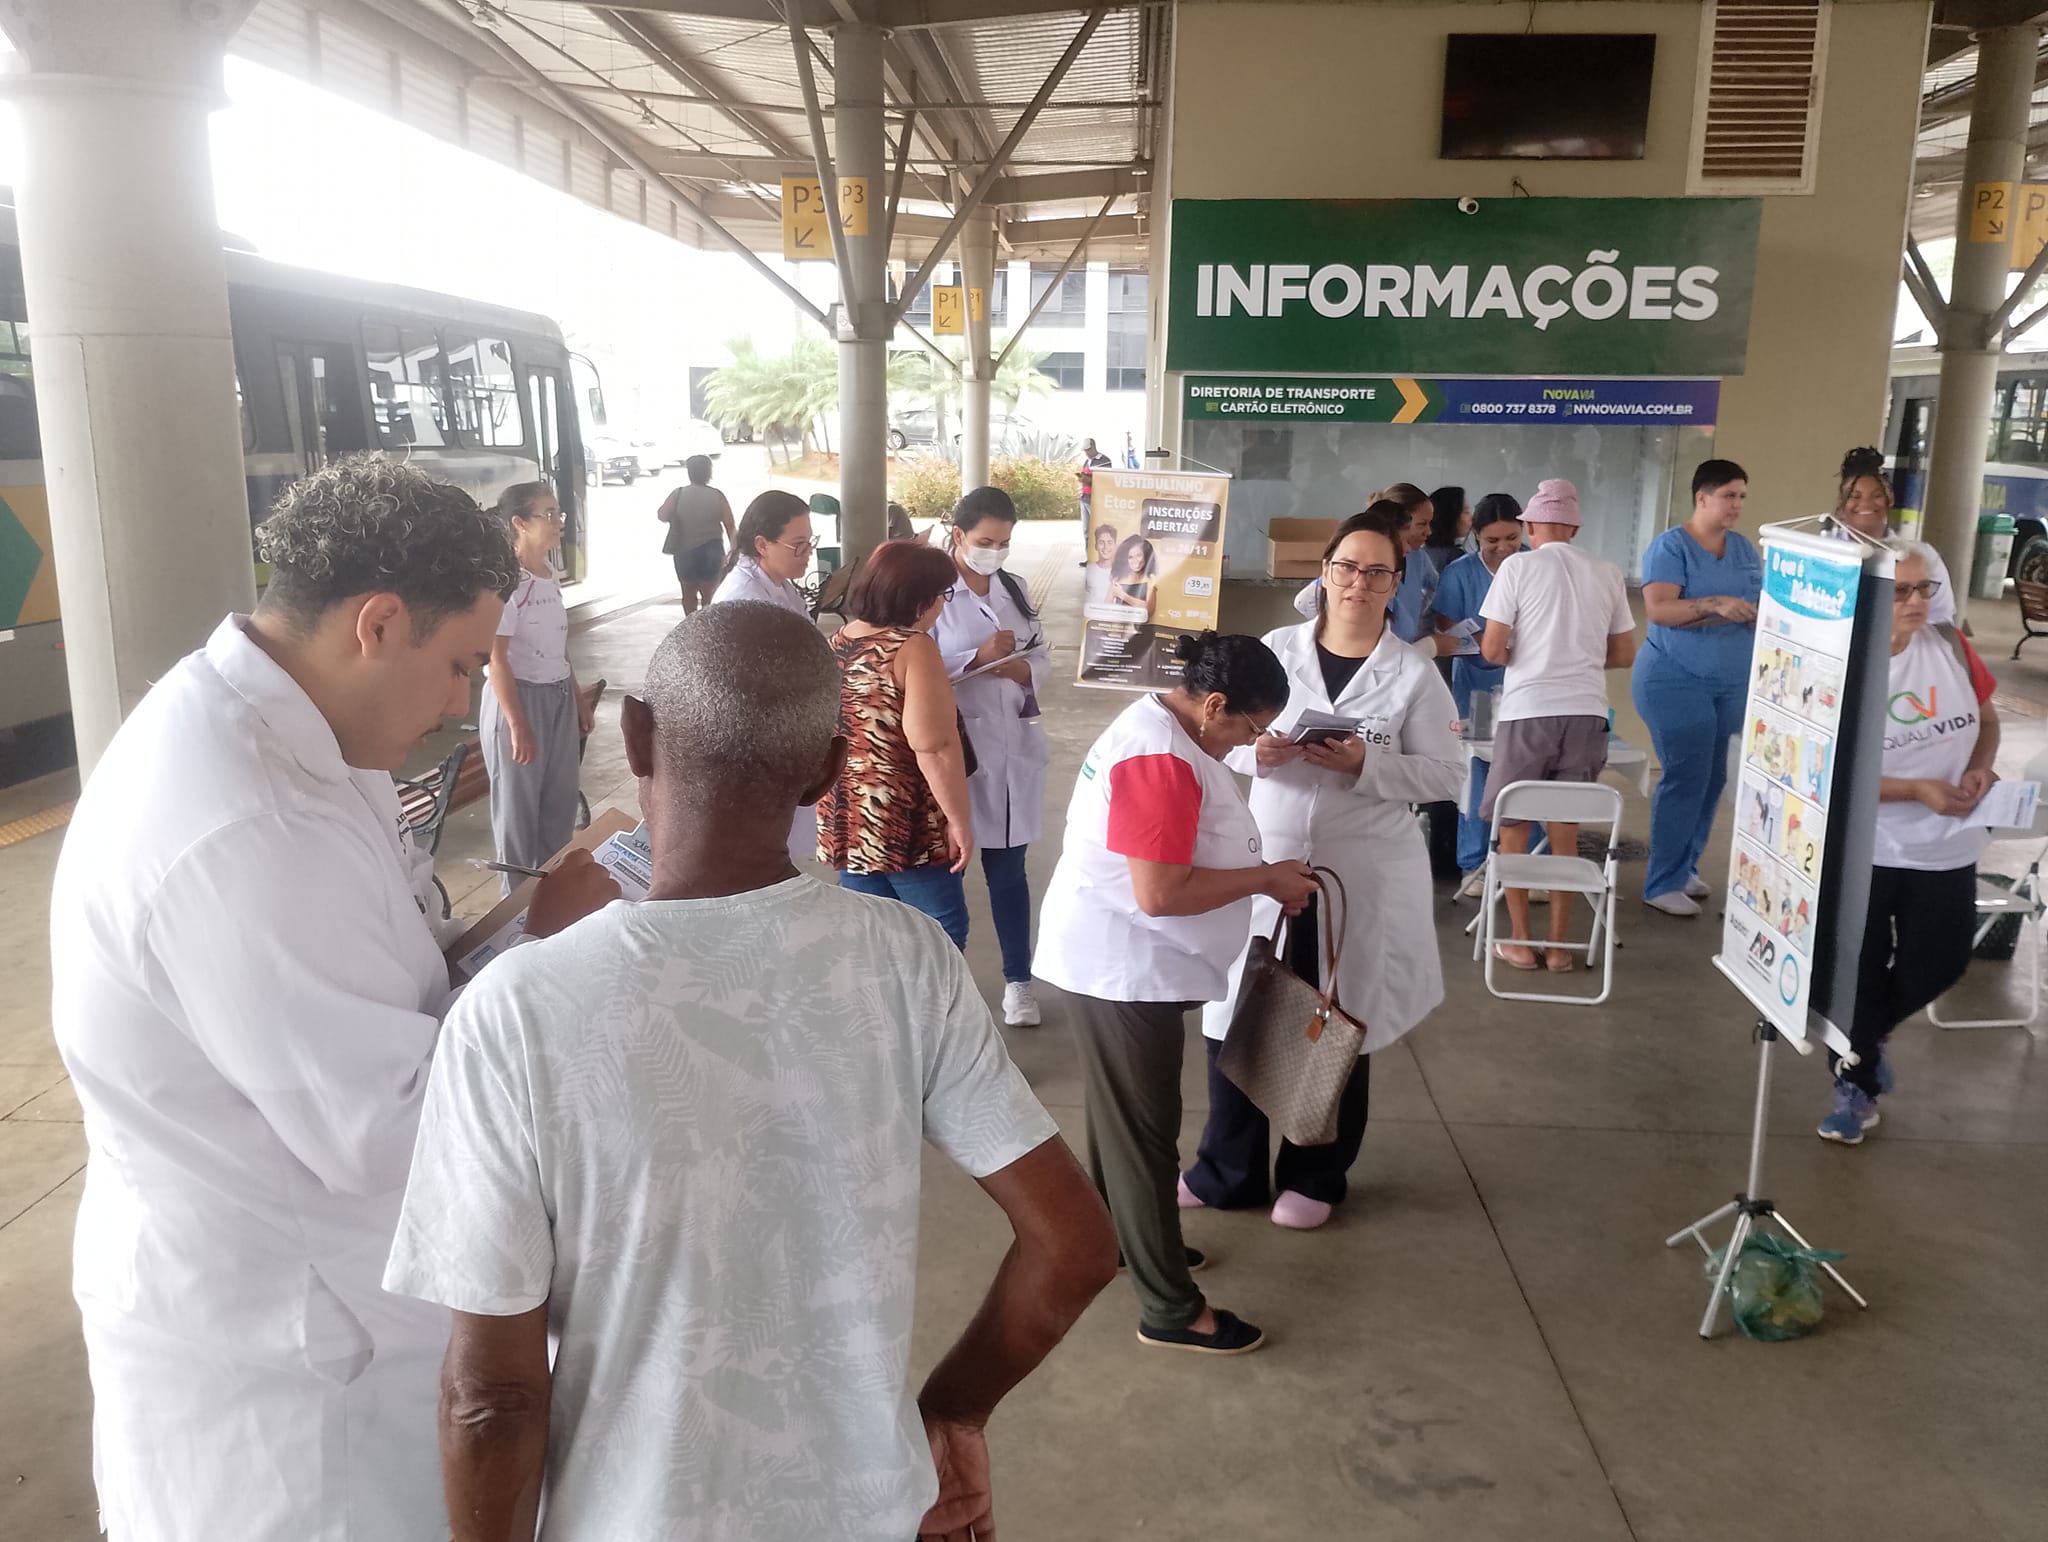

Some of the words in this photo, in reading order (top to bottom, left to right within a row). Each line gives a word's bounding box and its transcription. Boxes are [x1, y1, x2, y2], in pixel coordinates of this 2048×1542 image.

[842, 184, 864, 204] P3
[1977, 189, 2004, 210] P2
[2025, 192, 2048, 221] P
[1196, 249, 1720, 331] INFORMAÇÕES
[939, 292, 957, 309] P1
[1191, 386, 1262, 399] DIRETORIA
[1265, 387, 1283, 399] DE
[1286, 387, 1376, 400] TRANSPORTE
[1220, 400, 1269, 414] CARTÃO
[1270, 401, 1345, 415] ELETRÔNICO
[1471, 403, 1503, 414] 0800
[1505, 403, 1526, 414] 737
[1528, 403, 1557, 414] 8378
[1574, 403, 1693, 415] NVNOVAVIA.COM.BR
[1115, 475, 1204, 492] VESTIBULINHO
[1105, 495, 1136, 510] Etec
[1148, 505, 1213, 522] INSCRIÇÕES
[1147, 520, 1199, 534] ABERTAS!
